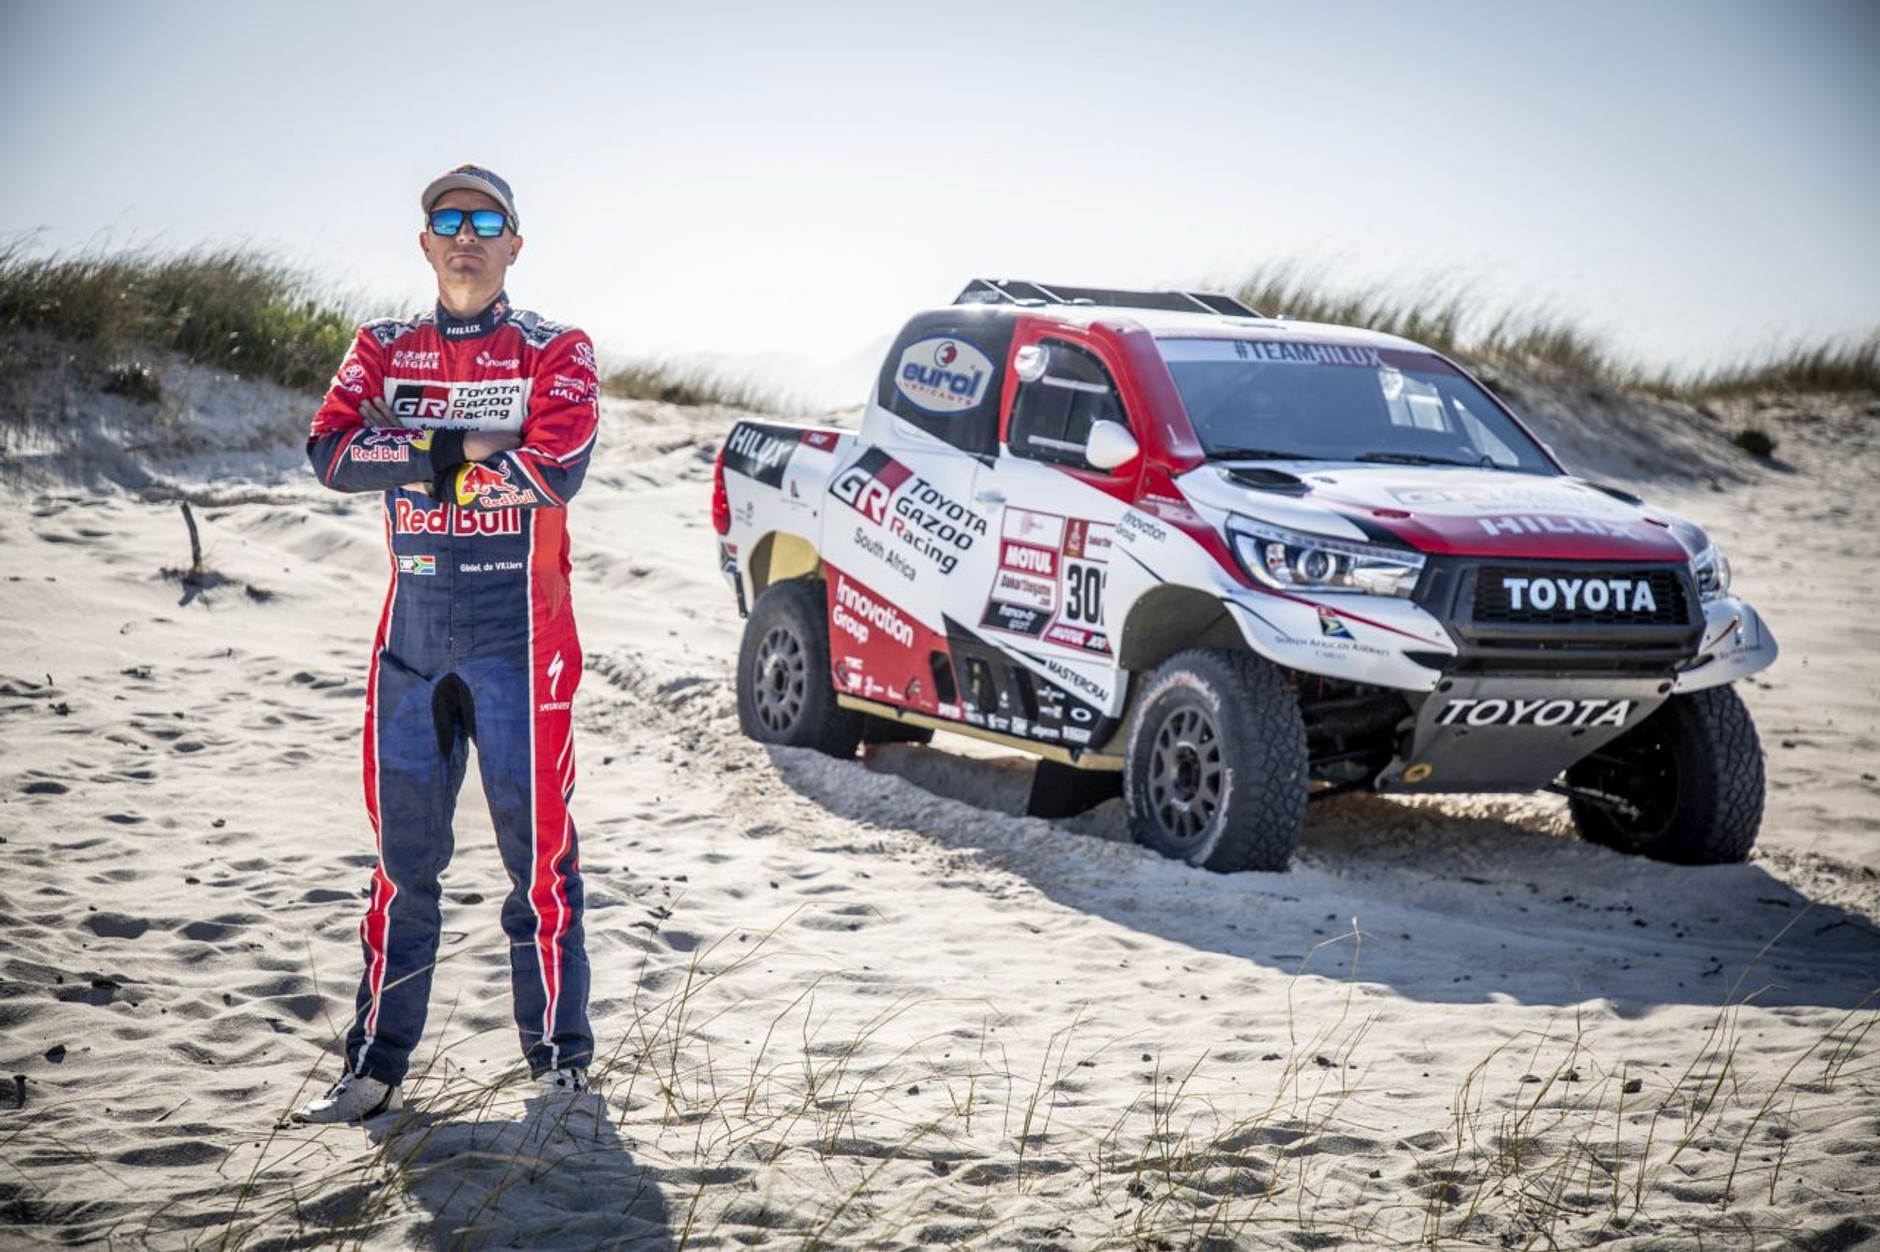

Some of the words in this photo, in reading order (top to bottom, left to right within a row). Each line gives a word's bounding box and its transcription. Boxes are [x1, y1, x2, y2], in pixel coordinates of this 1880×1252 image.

[446, 325, 481, 335] HILUX
[1235, 340, 1384, 366] #TEAMHILUX
[456, 386, 520, 397] TOYOTA
[902, 363, 984, 399] eurol
[393, 398, 449, 418] GR
[450, 407, 510, 420] Racing
[453, 397, 513, 409] GAZOO
[351, 445, 379, 461] Red
[381, 445, 409, 462] Bull
[729, 425, 793, 468] HILUX
[479, 494, 508, 508] Red
[509, 488, 538, 505] Bull
[832, 466, 892, 526] GR
[909, 478, 988, 536] TOYOTA
[396, 498, 450, 534] Red
[453, 503, 522, 536] Bull
[895, 496, 974, 551] GAZOO
[1477, 515, 1642, 540] HILUX
[854, 526, 885, 560] South
[885, 550, 916, 582] Africa
[889, 516, 958, 575] Racing
[1004, 544, 1053, 574] MOTUL
[1502, 578, 1657, 612] TOYOTA
[832, 604, 869, 645] Group
[836, 574, 914, 649] Innovation
[1441, 699, 1632, 727] TOYOTA
